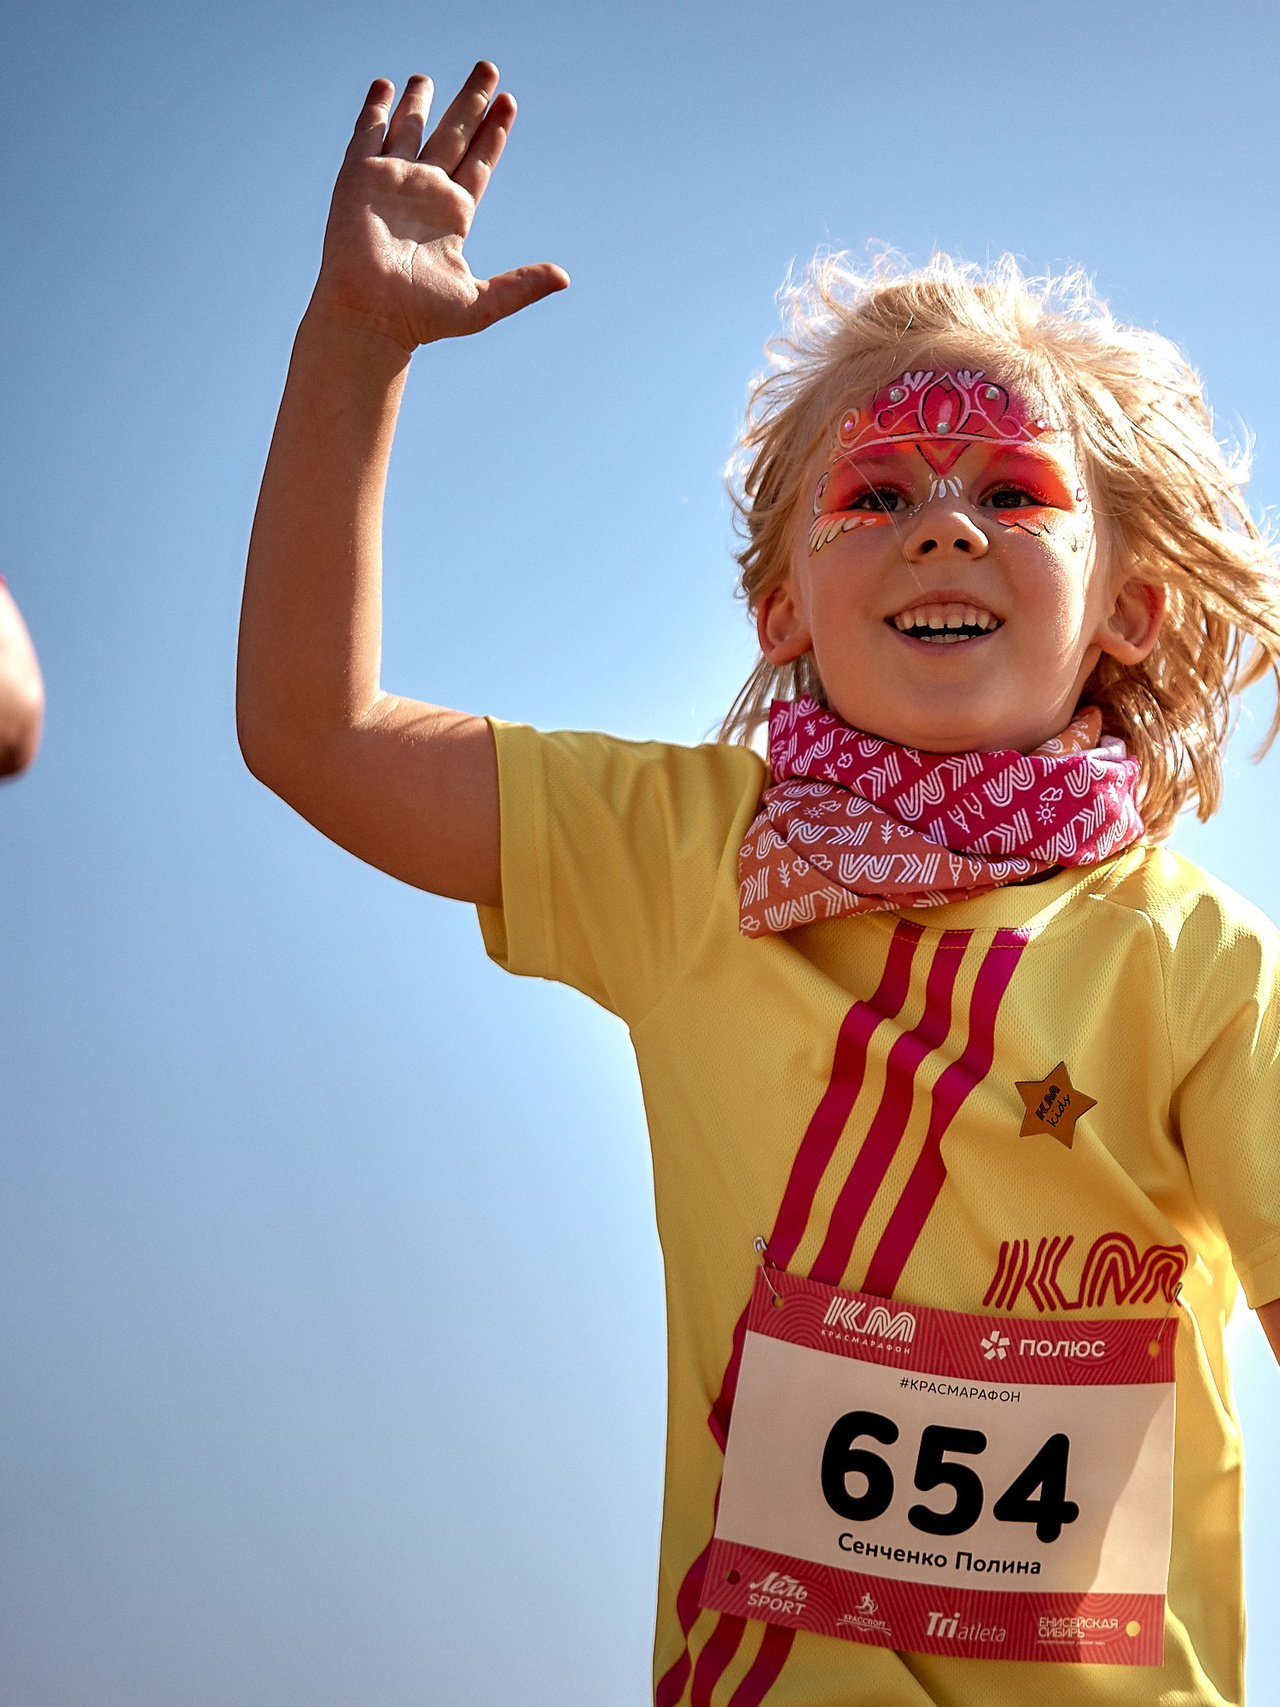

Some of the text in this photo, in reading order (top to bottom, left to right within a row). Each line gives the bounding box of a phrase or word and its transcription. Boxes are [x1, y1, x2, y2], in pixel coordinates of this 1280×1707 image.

[1047, 1094, 1071, 1128] kids
[821, 1328, 911, 1355] КРАСМАРАФОН
[1019, 1339, 1106, 1358] ПОЛЮС
[899, 1377, 1021, 1403] #КРАСМАРАФОН
[821, 1410, 1080, 1543] 654
[838, 1532, 1041, 1575] Сенченко Полина
[747, 1593, 807, 1616] SPORT
[1038, 1626, 1085, 1639] СИБИРЬ
[1039, 1615, 1119, 1630] ЕНИСЕЙСКАЯ
